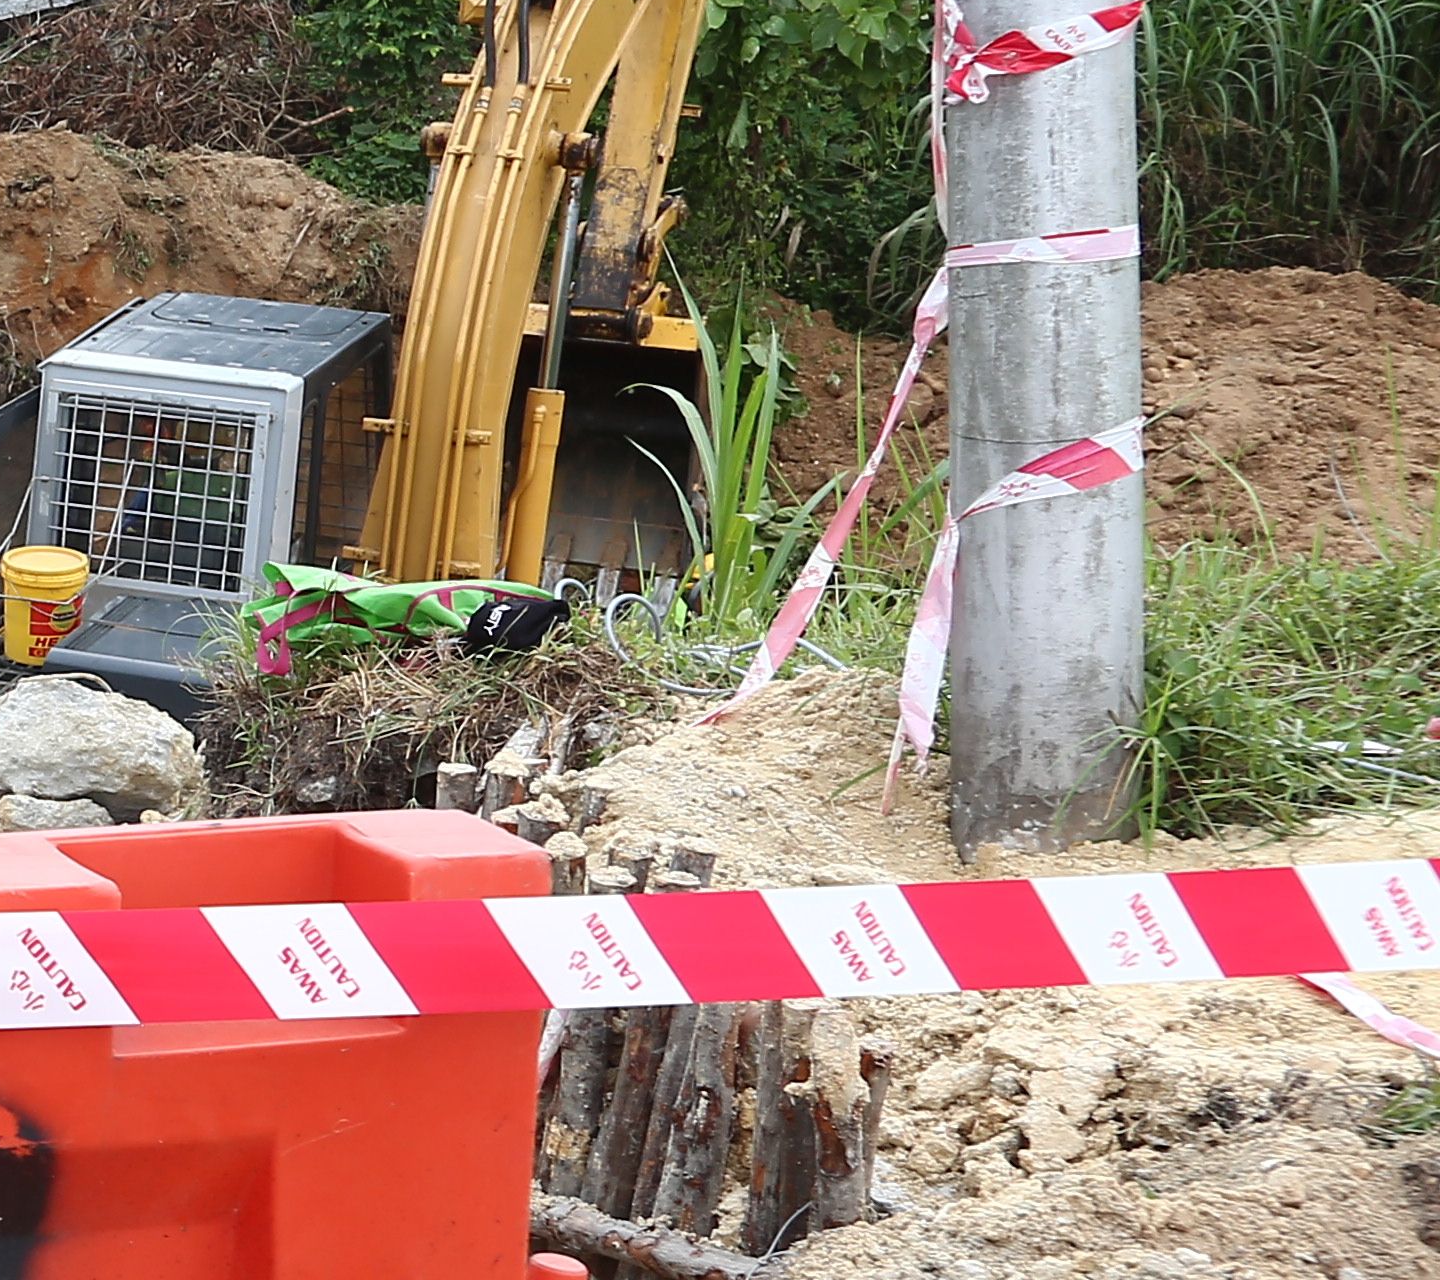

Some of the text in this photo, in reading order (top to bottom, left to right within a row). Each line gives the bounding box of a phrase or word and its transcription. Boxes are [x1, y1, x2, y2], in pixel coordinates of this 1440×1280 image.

[586, 913, 642, 990] CAUTION
[855, 901, 905, 976] CAUTION
[1130, 893, 1177, 967] CAUTION
[1386, 876, 1435, 953] CAUTION
[18, 928, 87, 1011] CAUTION
[279, 947, 327, 1003] AWAS
[300, 918, 360, 998] CAUTION
[832, 930, 872, 981] AWAS
